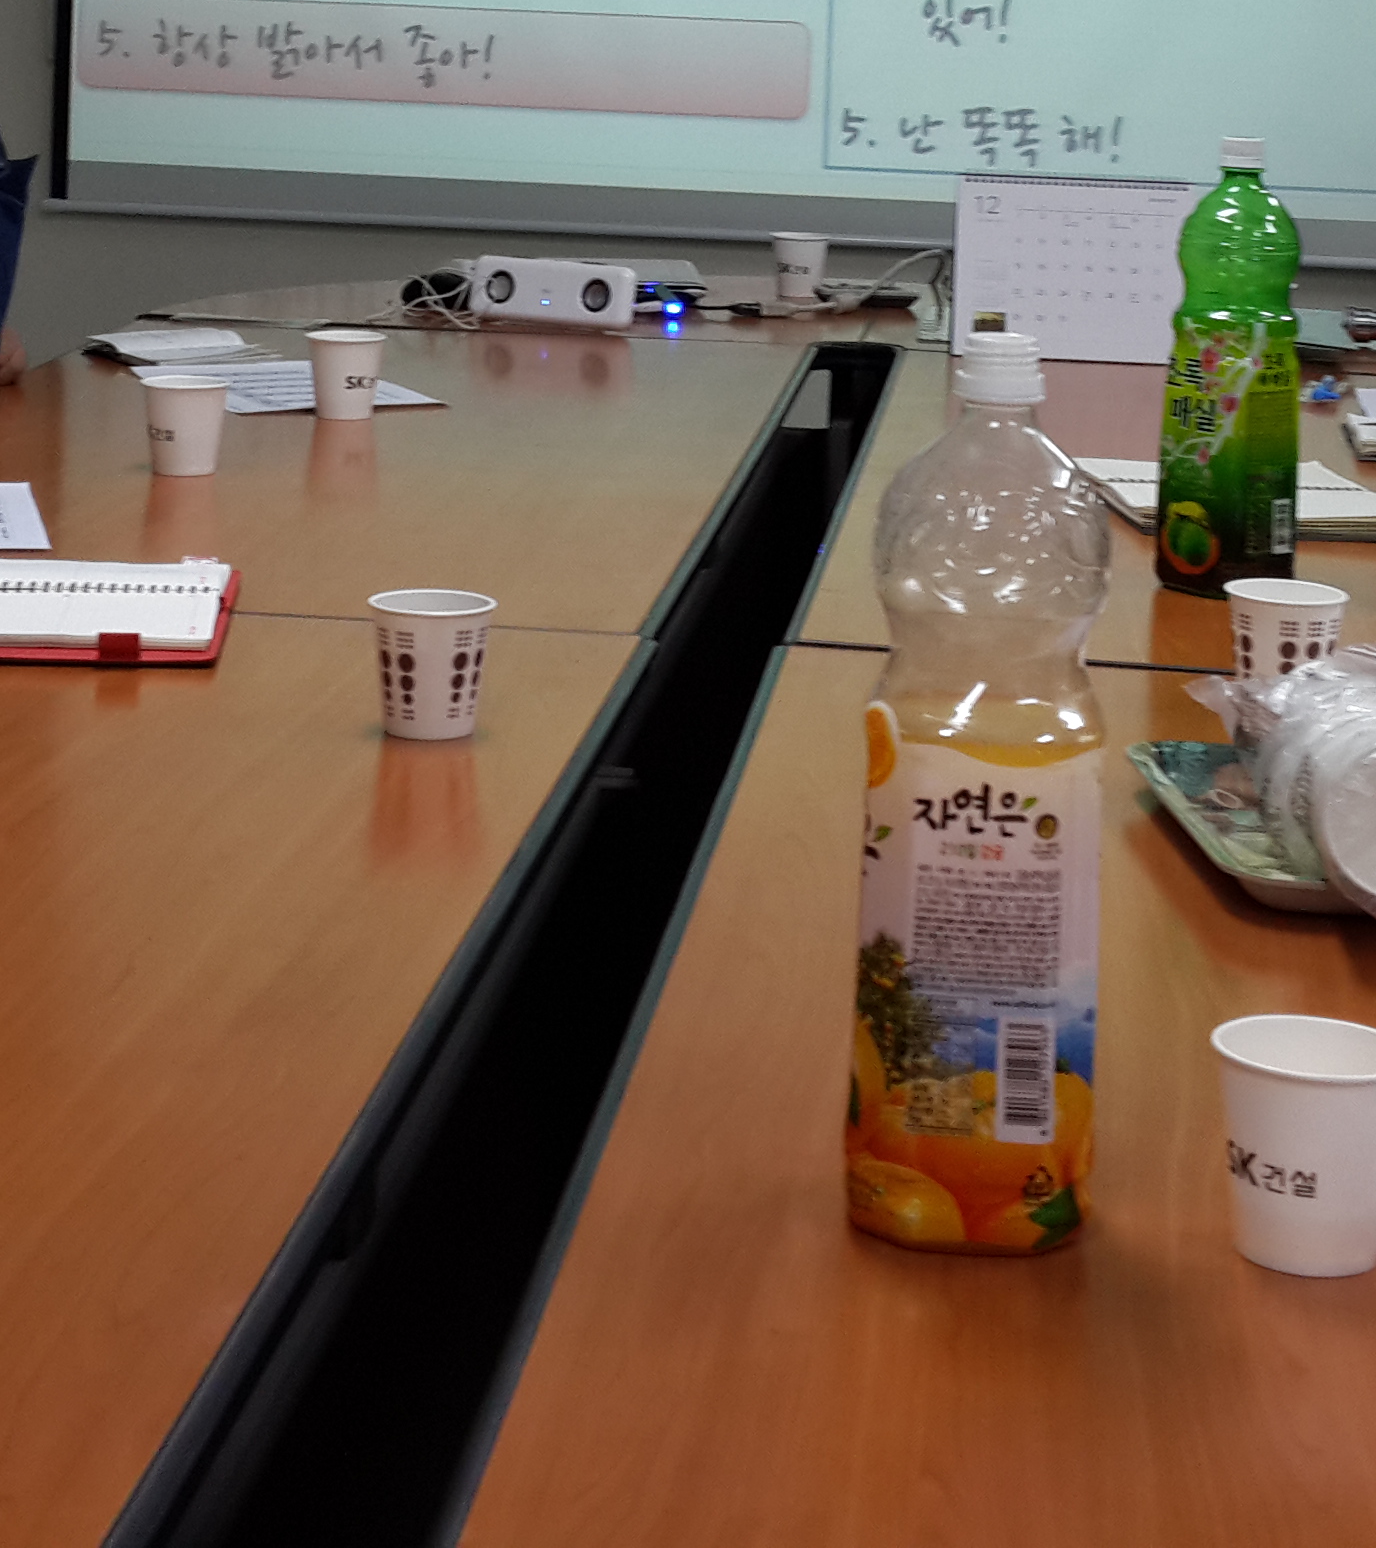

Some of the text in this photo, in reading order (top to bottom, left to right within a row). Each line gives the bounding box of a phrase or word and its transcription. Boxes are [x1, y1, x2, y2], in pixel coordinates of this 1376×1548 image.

[98, 18, 495, 89] 5. 항상 밝아서 좋아!
[841, 107, 876, 148] 5.
[899, 113, 944, 155] 난
[975, 196, 1001, 215] 12
[914, 782, 1027, 838] 자연은
